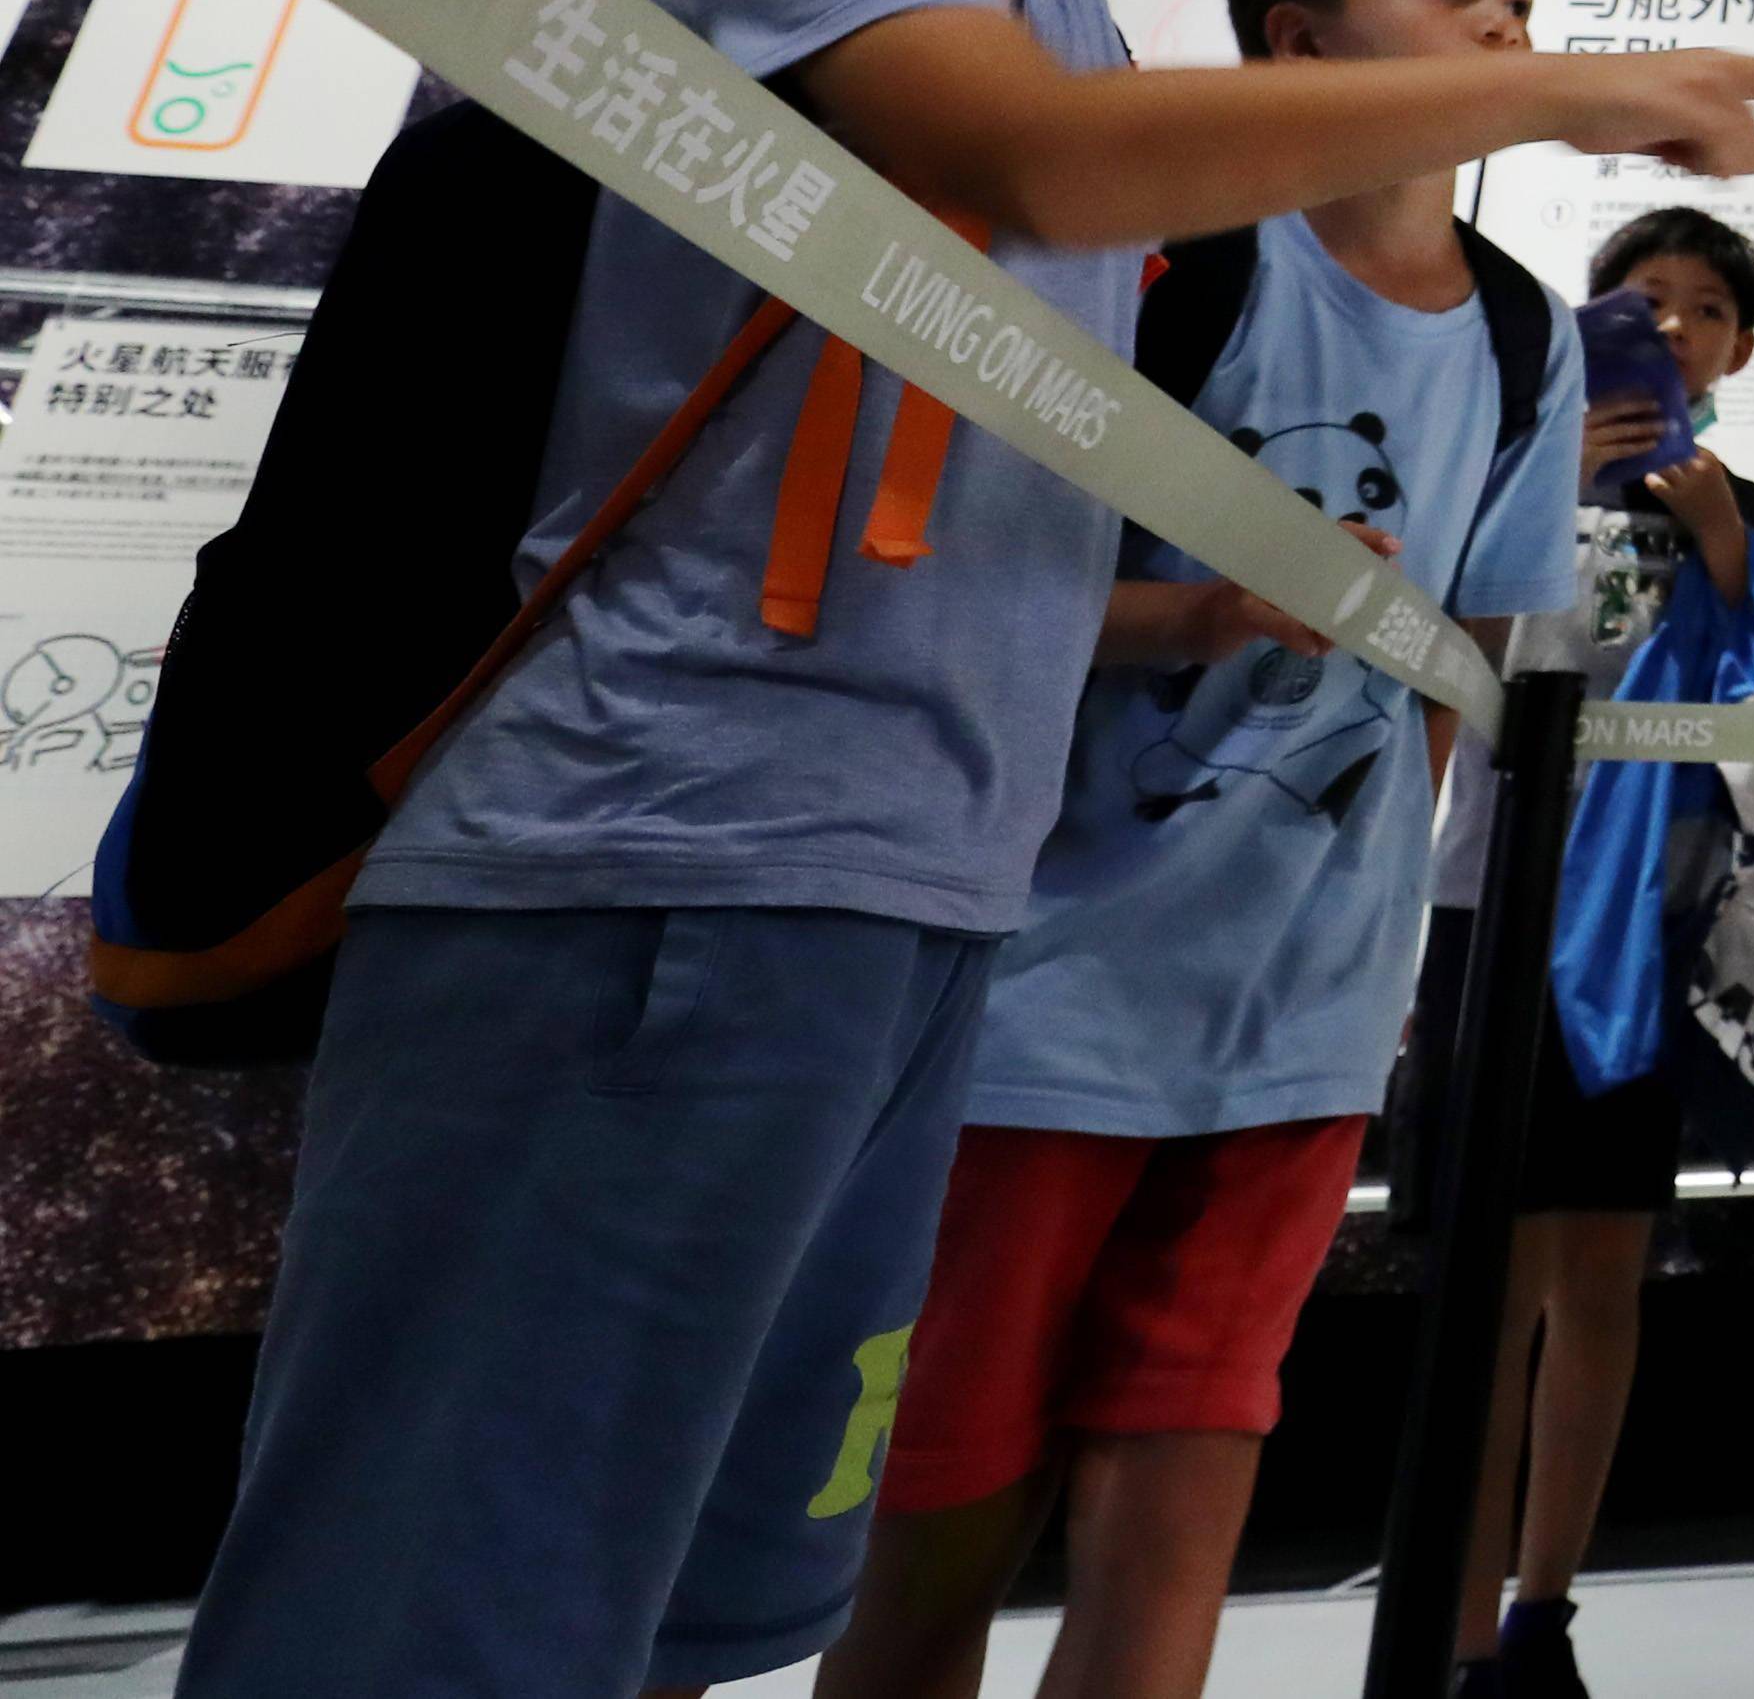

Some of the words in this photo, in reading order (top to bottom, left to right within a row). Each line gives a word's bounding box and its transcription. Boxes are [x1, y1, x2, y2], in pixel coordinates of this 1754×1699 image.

[861, 240, 994, 364] LIVING
[976, 325, 1048, 399] ON
[1023, 356, 1122, 450] MARS
[48, 382, 216, 420] 特别之处
[1625, 716, 1714, 747] MARS
